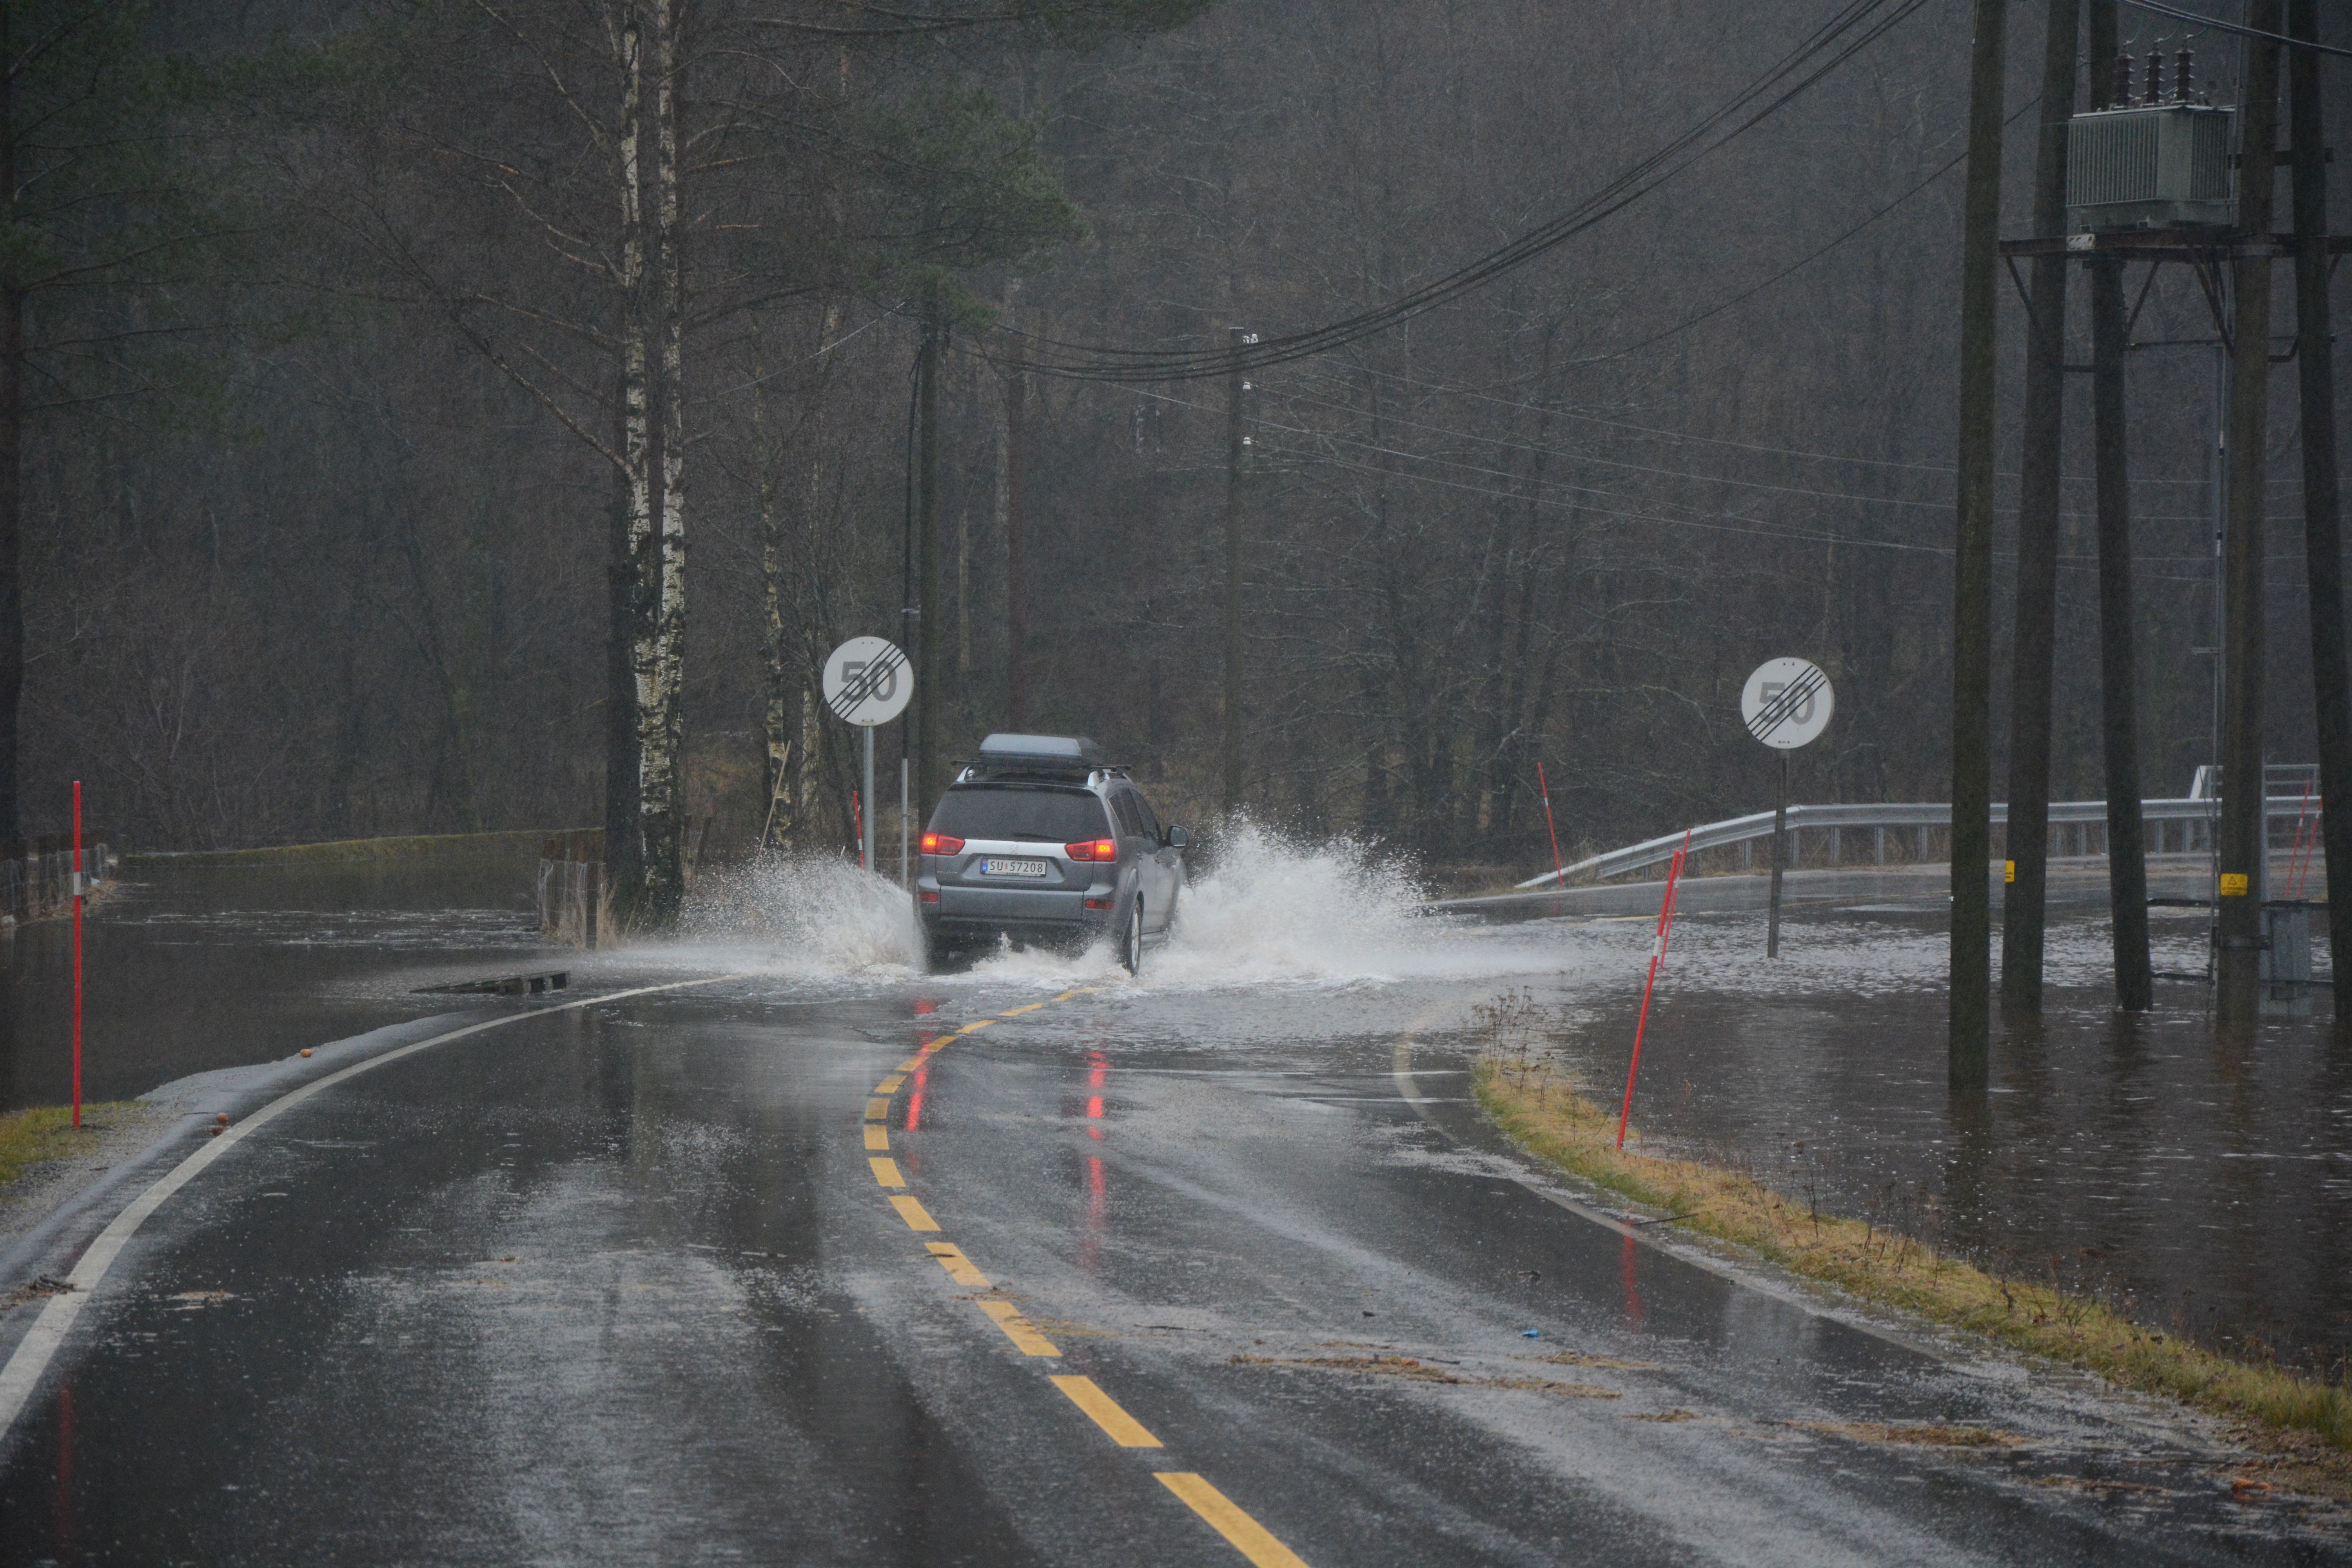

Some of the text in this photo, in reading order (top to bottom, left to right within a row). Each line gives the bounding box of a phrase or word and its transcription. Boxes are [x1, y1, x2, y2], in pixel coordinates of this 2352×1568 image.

[841, 660, 897, 702] 50
[1759, 682, 1815, 725] 50
[990, 861, 1043, 873] SU 57208
